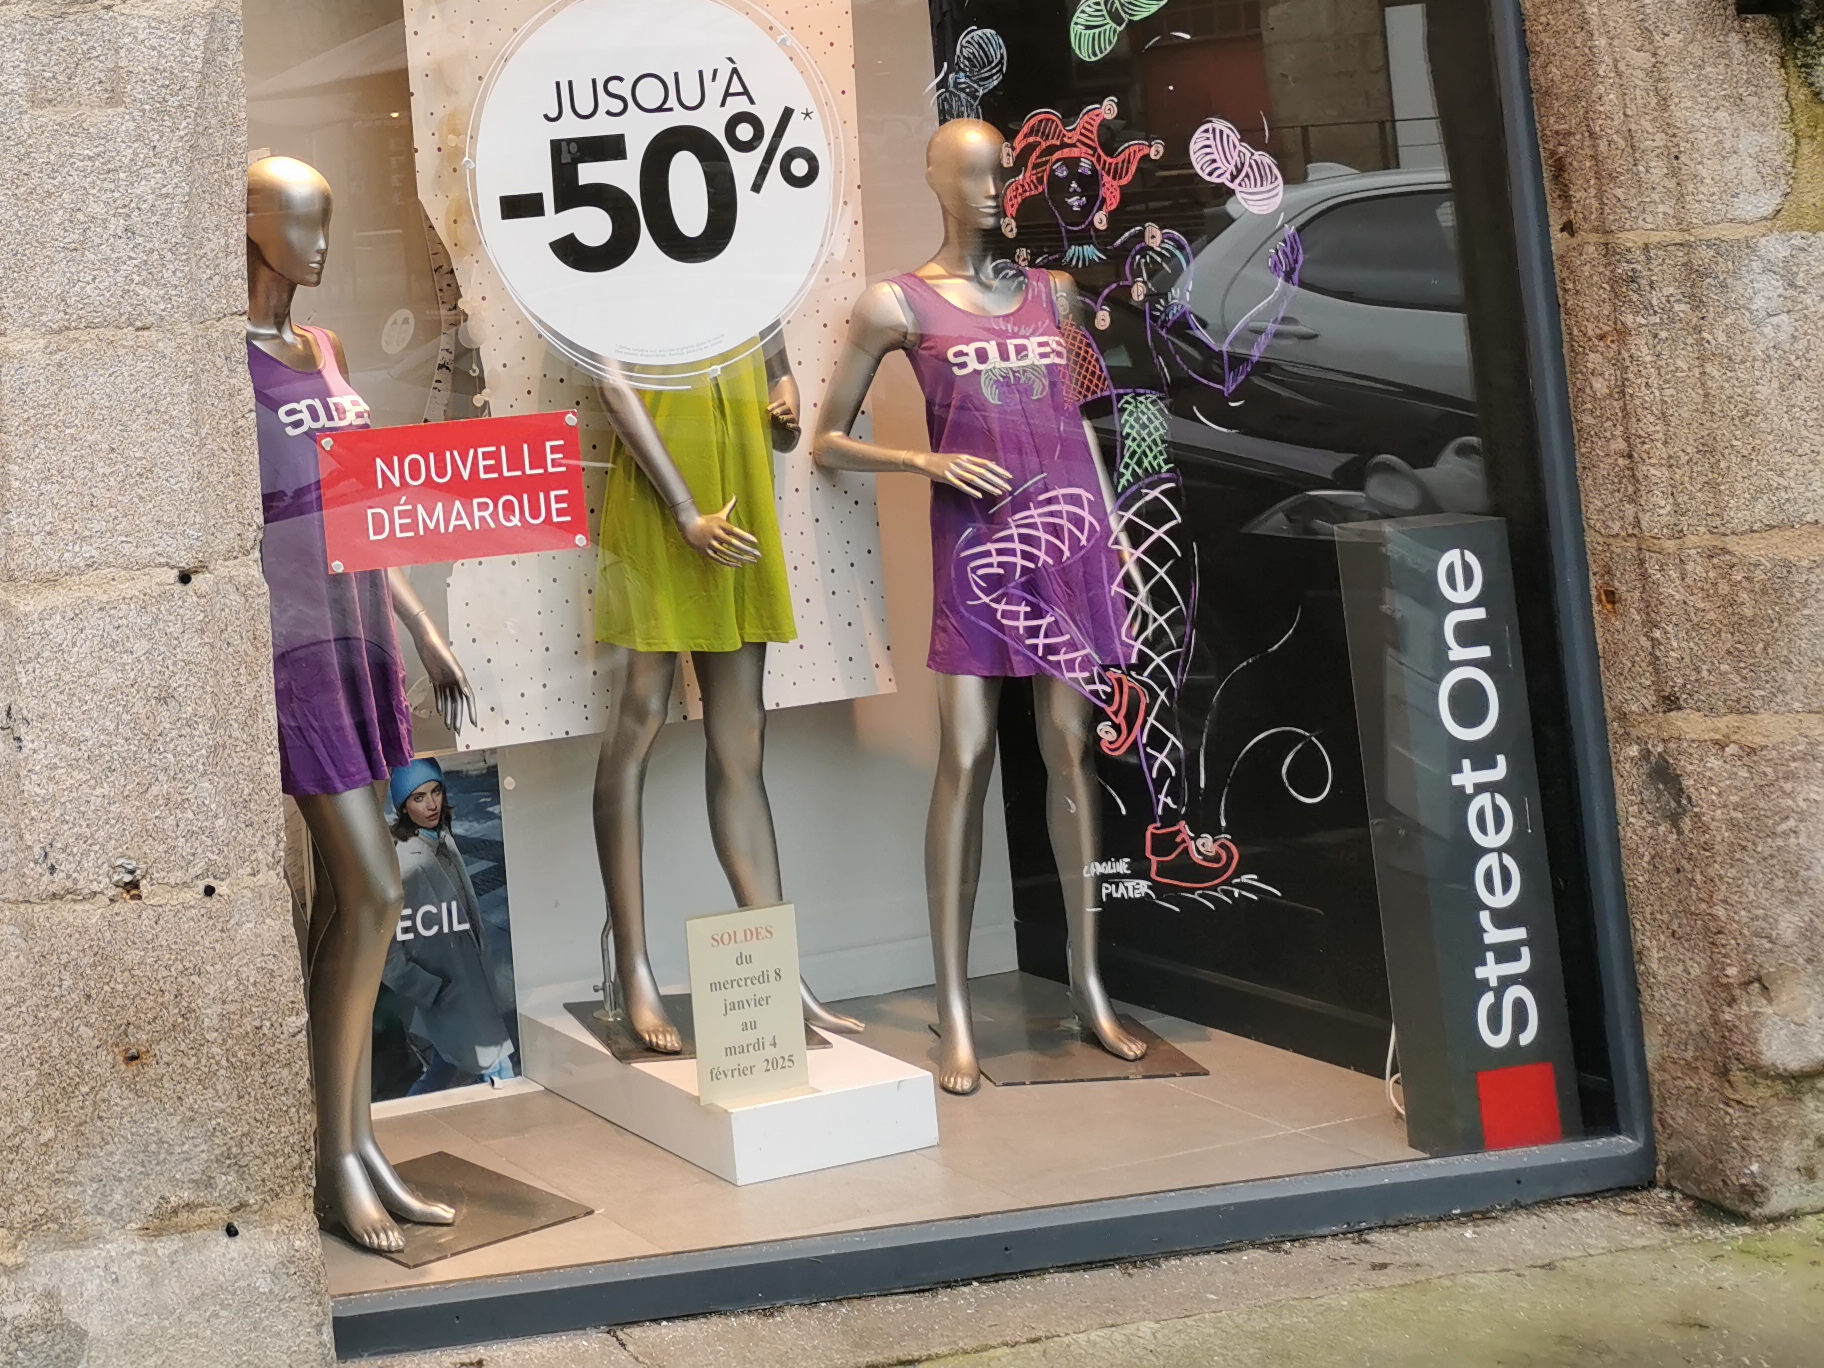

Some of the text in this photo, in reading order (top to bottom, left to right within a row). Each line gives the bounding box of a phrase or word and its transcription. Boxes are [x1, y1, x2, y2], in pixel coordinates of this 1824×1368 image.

[543, 56, 756, 122] JUSQU'À
[947, 336, 1067, 376] SOLDES
[277, 394, 371, 436] SOLDE
[376, 439, 567, 489] NOUVELLE
[366, 489, 572, 541] DÉMARQUE
[1437, 548, 1539, 1050] Street One
[396, 900, 470, 942] ECIL
[711, 925, 774, 948] SOLDES
[735, 951, 753, 966] du
[709, 967, 782, 993] mercredi 8
[722, 993, 772, 1017] janvier
[741, 1019, 757, 1032] au
[724, 1035, 777, 1057] mardi 4
[709, 1054, 795, 1082] février 2025
